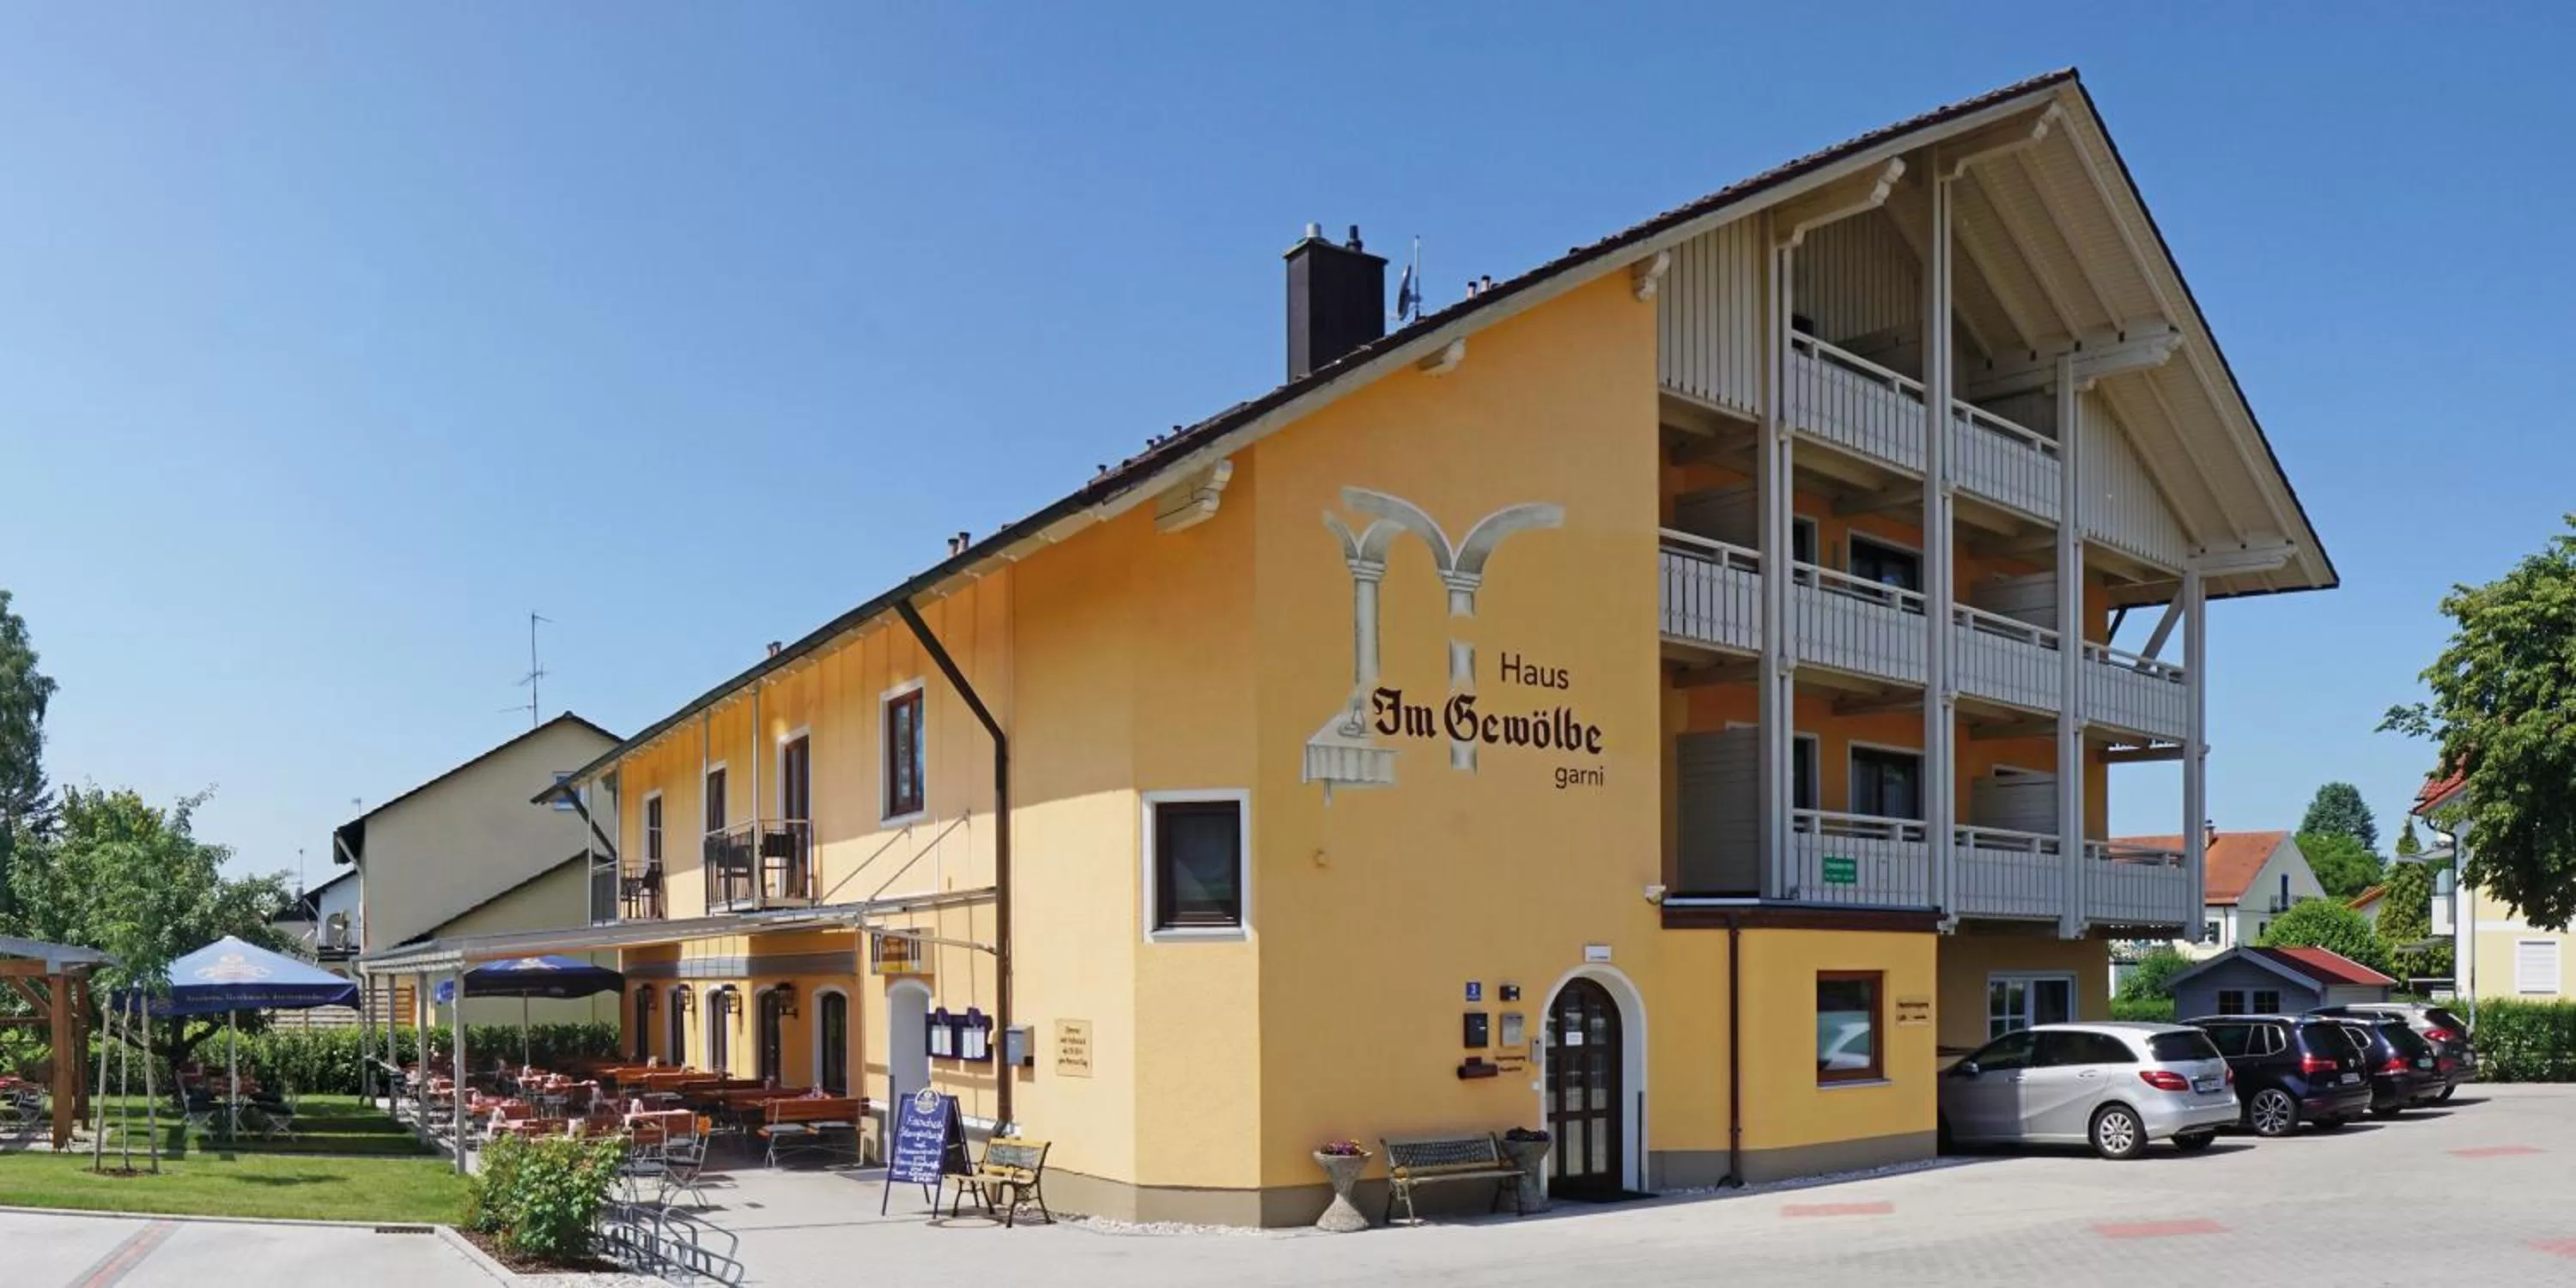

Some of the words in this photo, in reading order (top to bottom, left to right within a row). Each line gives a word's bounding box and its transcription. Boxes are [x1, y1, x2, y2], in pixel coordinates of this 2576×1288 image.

[1501, 652, 1570, 690] Haus
[1371, 686, 1437, 738] Im
[1443, 693, 1603, 755] Gewölbe
[1555, 766, 1604, 789] garni
